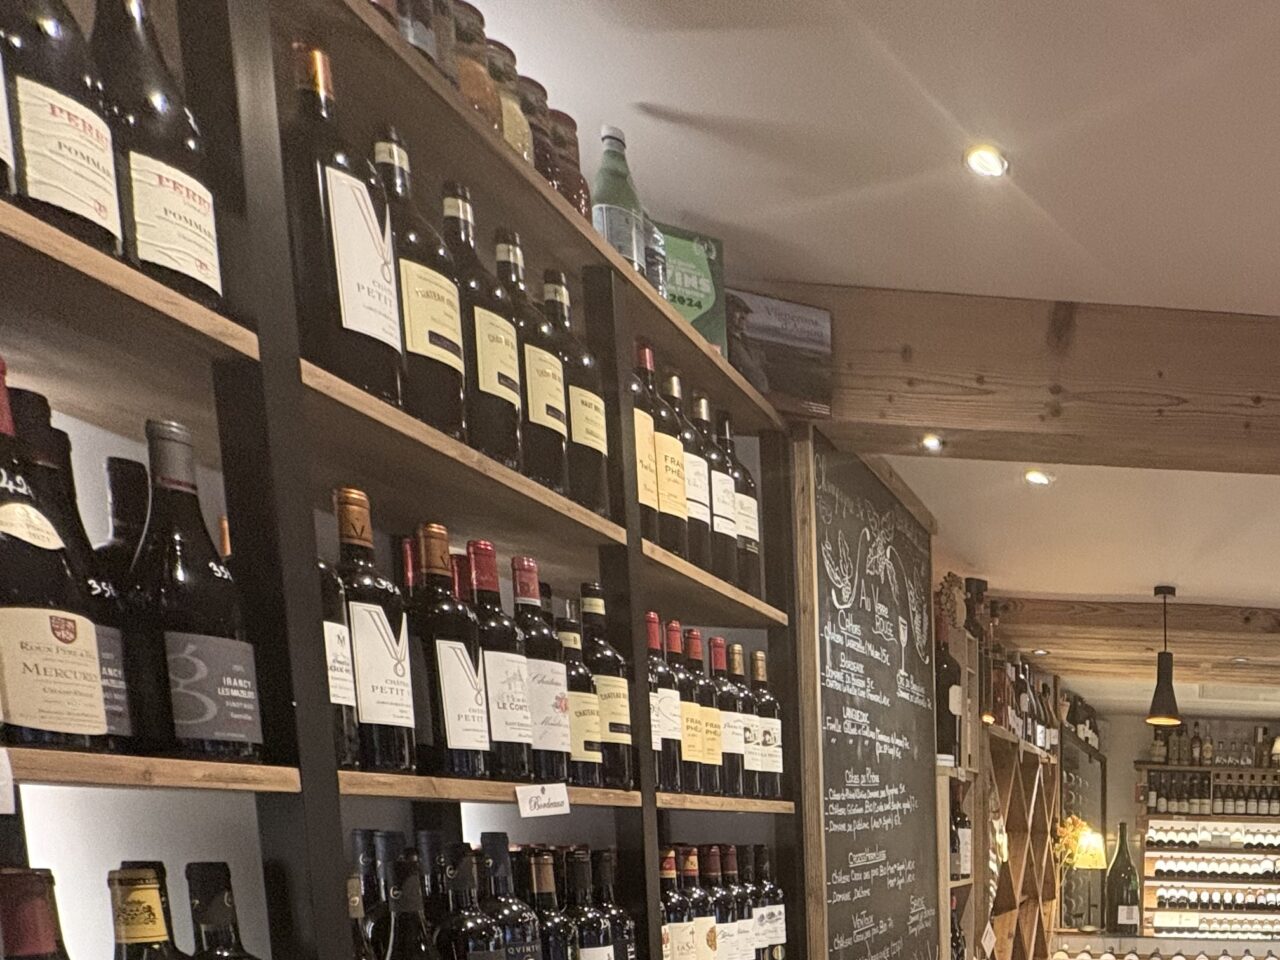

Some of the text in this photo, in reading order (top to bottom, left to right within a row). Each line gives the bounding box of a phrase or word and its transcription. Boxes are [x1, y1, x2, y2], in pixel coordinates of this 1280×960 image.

[668, 292, 704, 310] 2024
[222, 676, 252, 689] IRANCY
[528, 795, 565, 812] Bordeaux
